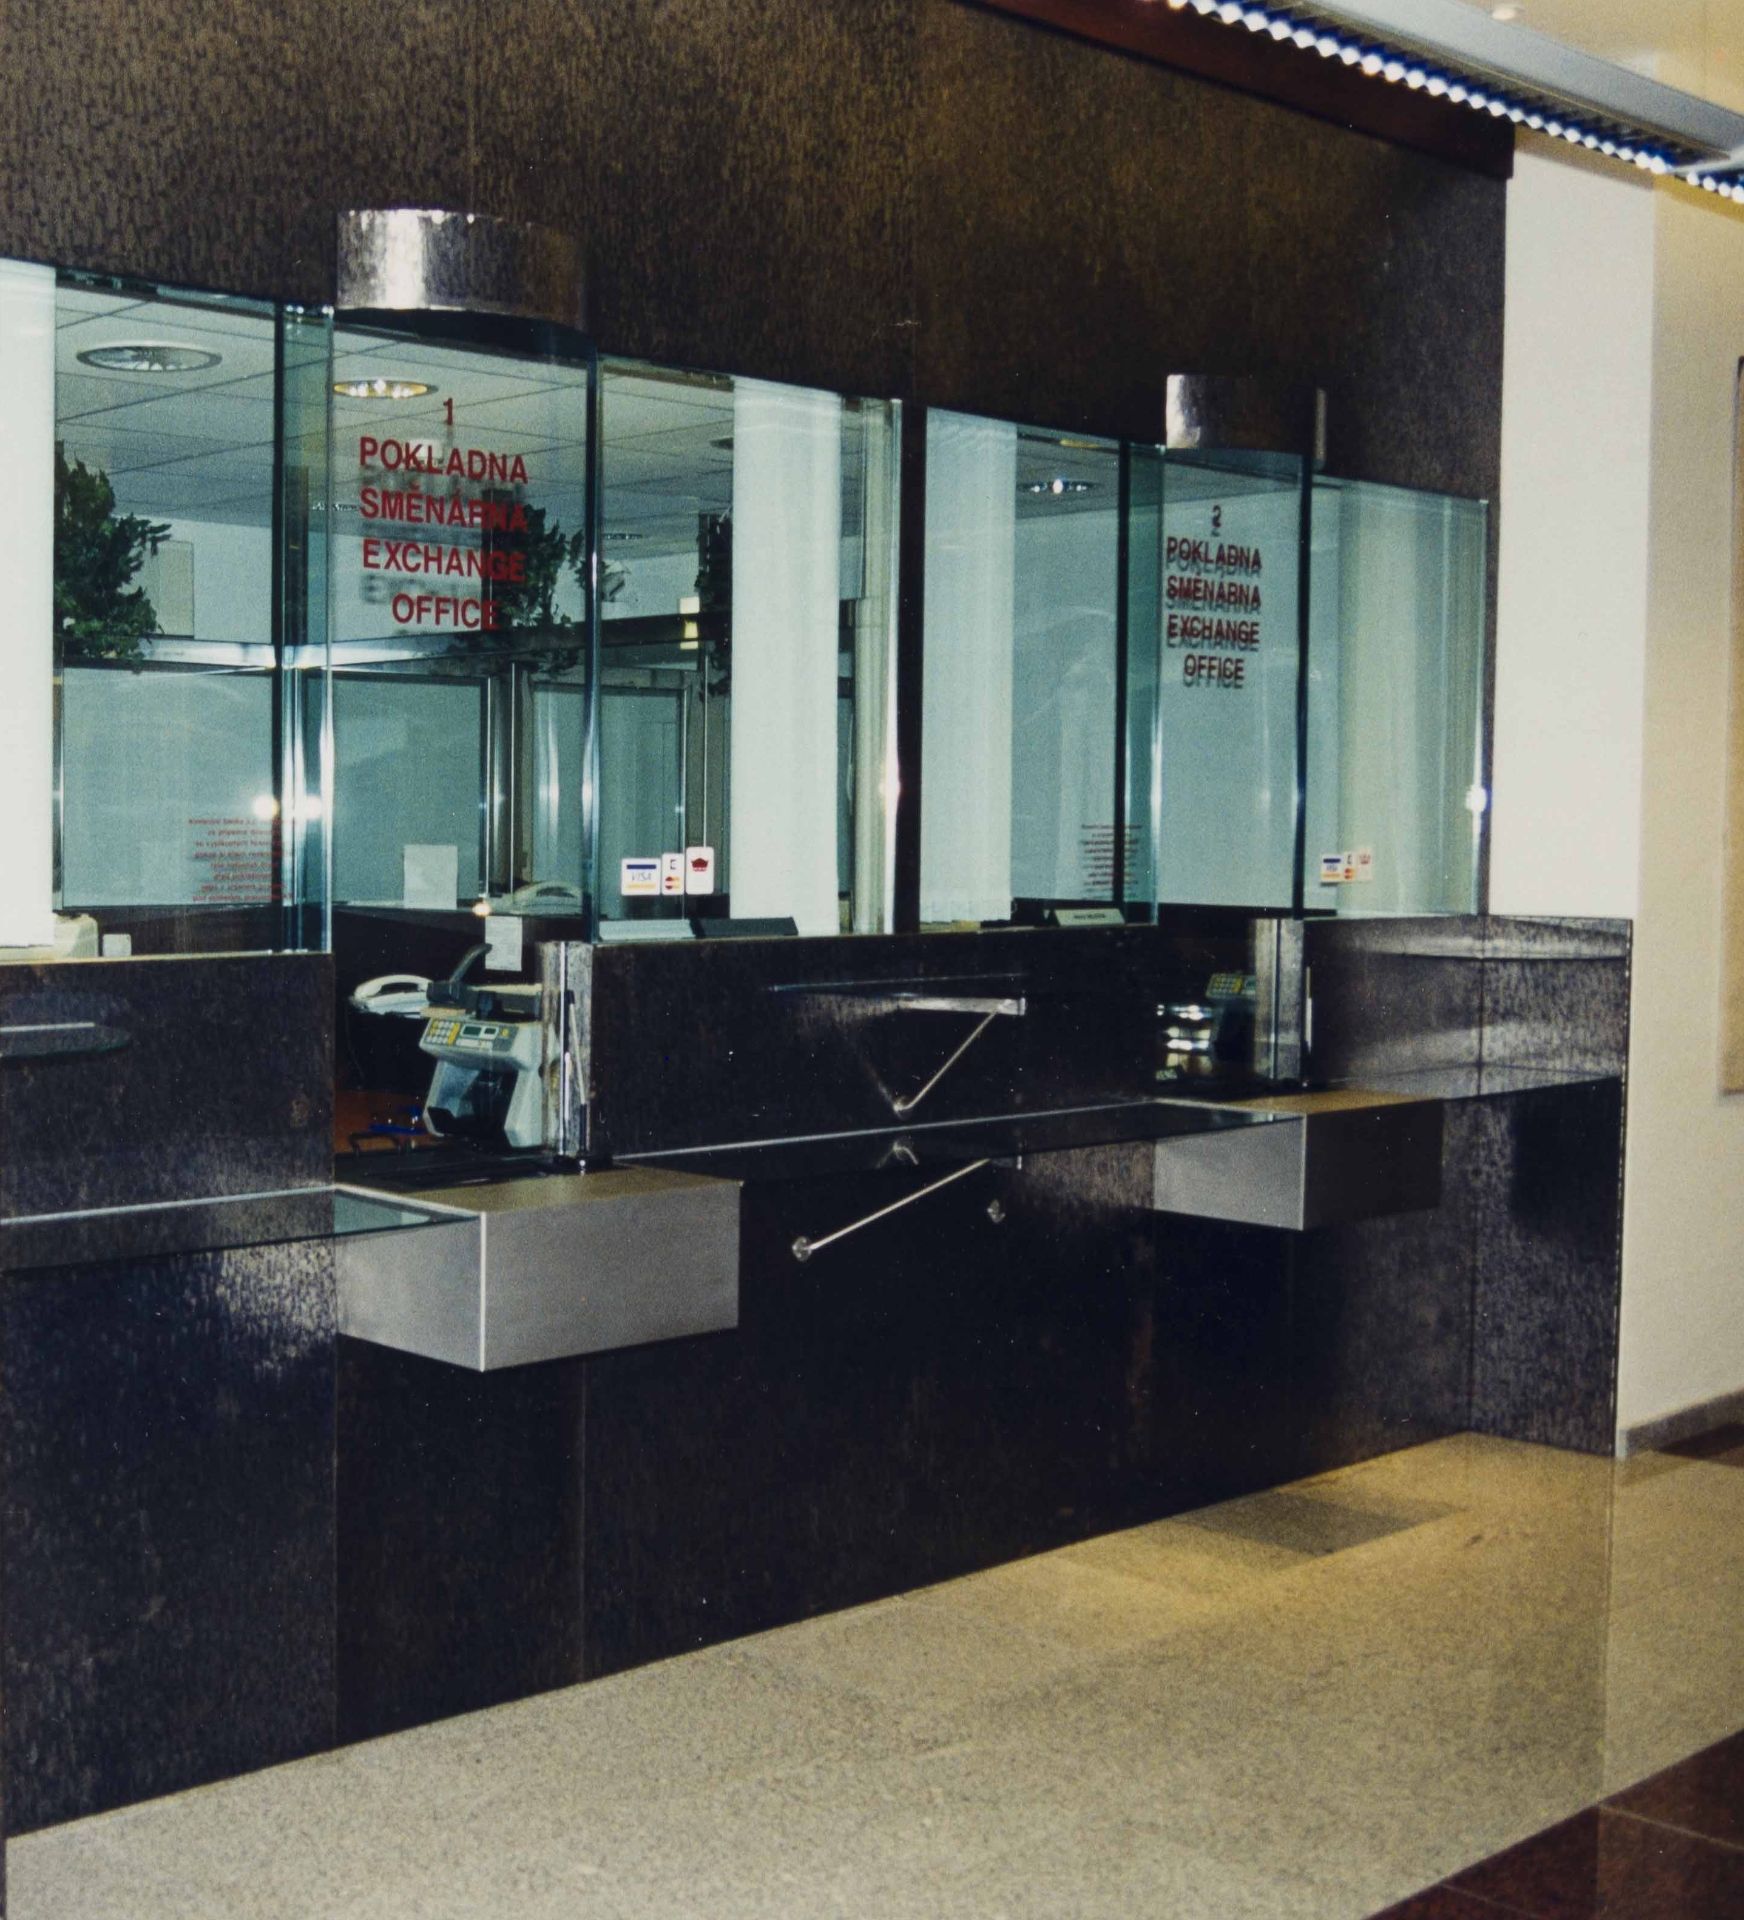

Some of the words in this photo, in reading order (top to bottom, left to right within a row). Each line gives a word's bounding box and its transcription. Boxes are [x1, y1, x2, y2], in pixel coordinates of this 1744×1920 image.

[443, 398, 455, 426] 1
[359, 436, 529, 485] POKLADNA
[359, 481, 528, 533] SMĚNÁRNA
[362, 538, 527, 582] EXCHANGE
[1166, 536, 1263, 571] POKLADNA
[392, 593, 501, 630] OFFICE
[1166, 614, 1261, 645] EXCHANGE
[1183, 654, 1245, 681] OFFICE
